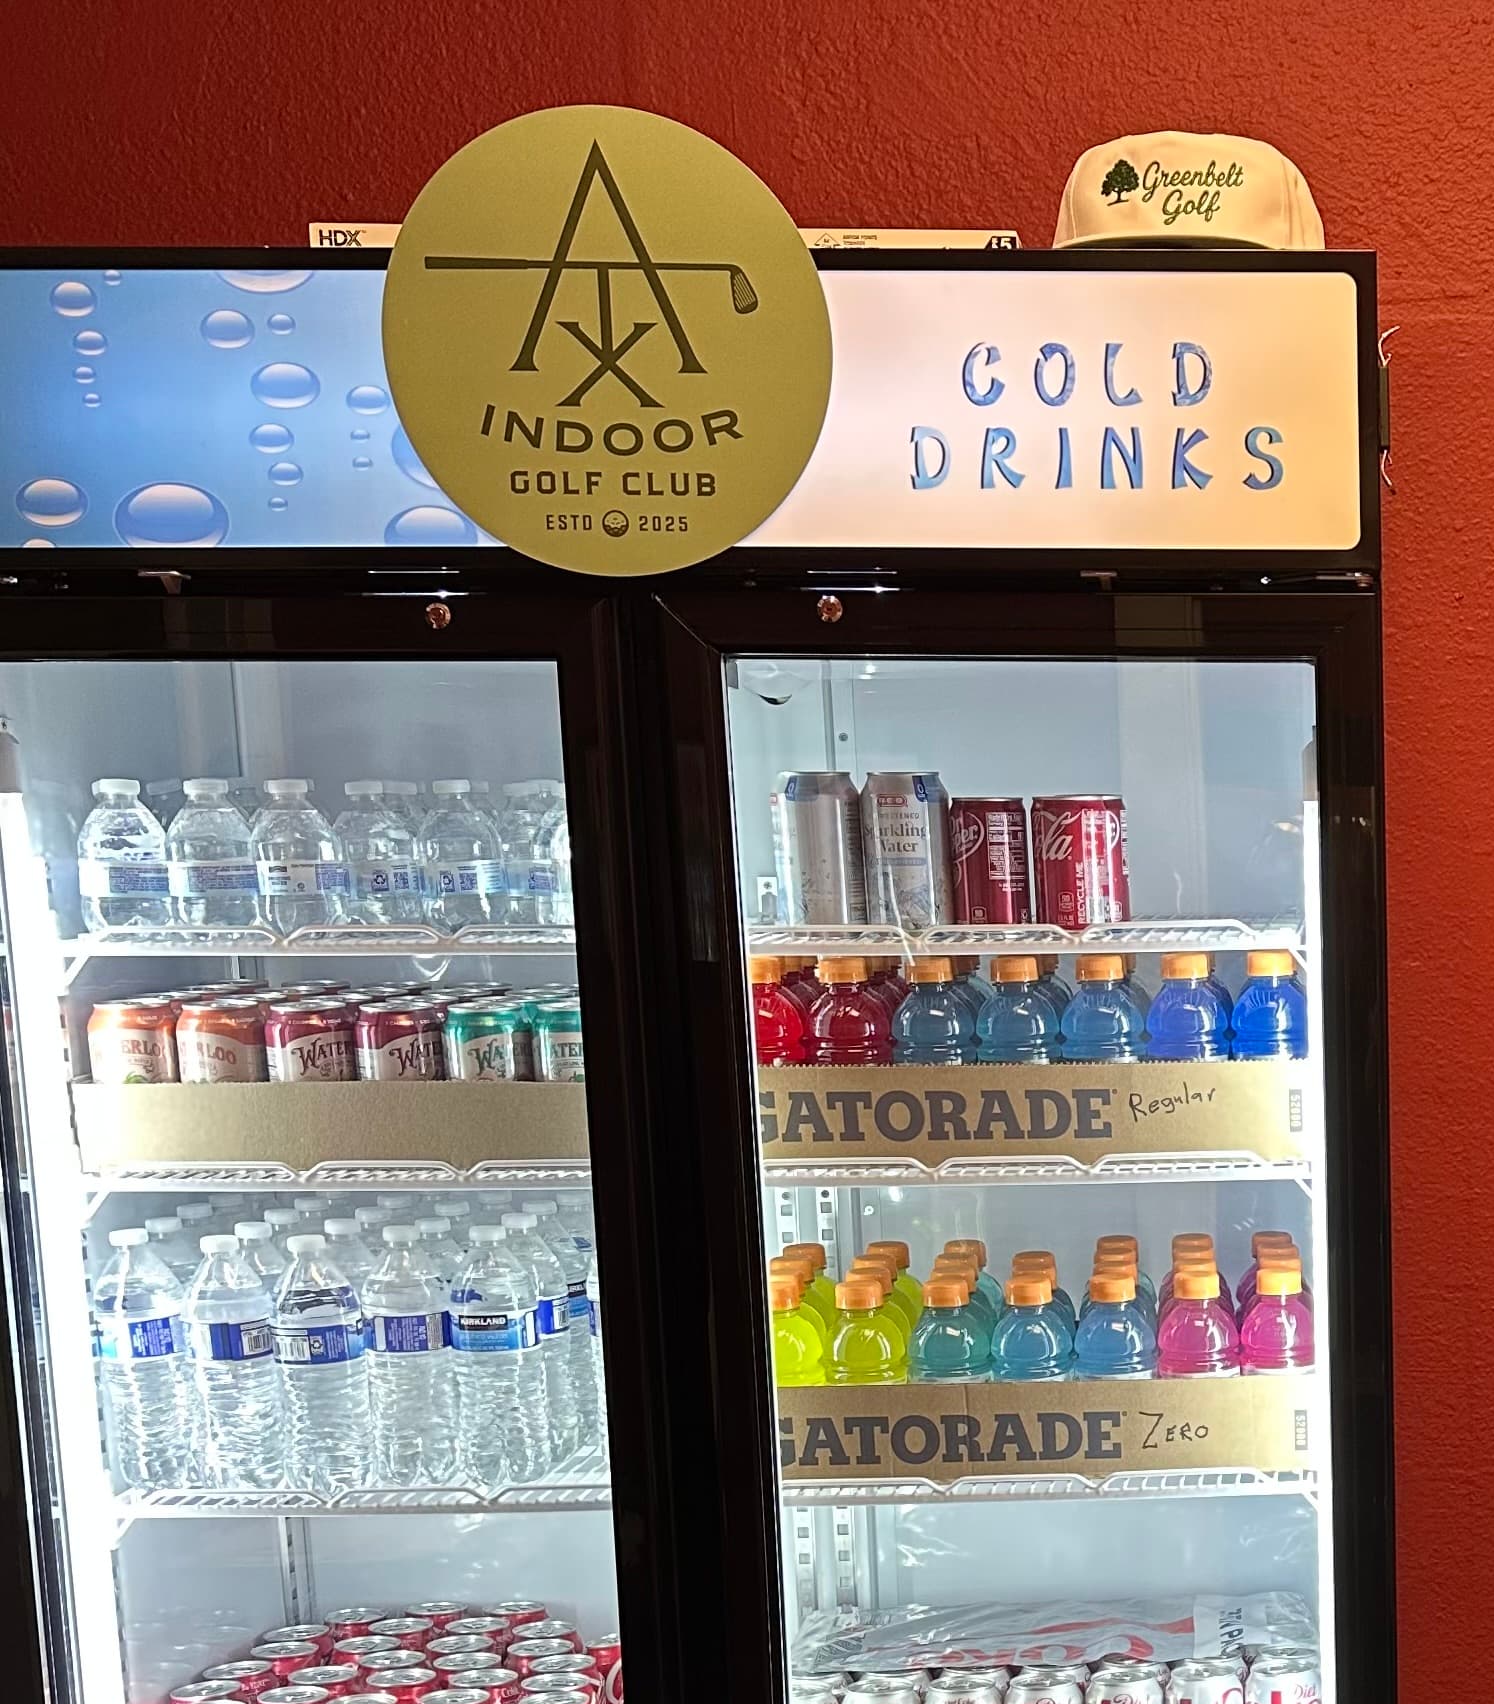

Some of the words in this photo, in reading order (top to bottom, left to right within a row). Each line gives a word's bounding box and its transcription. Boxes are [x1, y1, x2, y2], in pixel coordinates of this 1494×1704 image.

[1141, 159, 1244, 202] Greenbelt
[1162, 188, 1221, 226] Golf
[962, 341, 1213, 407] COLD
[480, 403, 745, 457] INDOOR
[910, 426, 1284, 490] DRINKS
[509, 470, 602, 495] GOLF
[621, 471, 717, 497] CLUB
[545, 514, 593, 532] ESTD
[638, 515, 689, 533] 2025
[1075, 879, 1086, 925] RECYCLE
[1128, 1081, 1216, 1123] Regular
[460, 1316, 507, 1326] KIRKLAND
